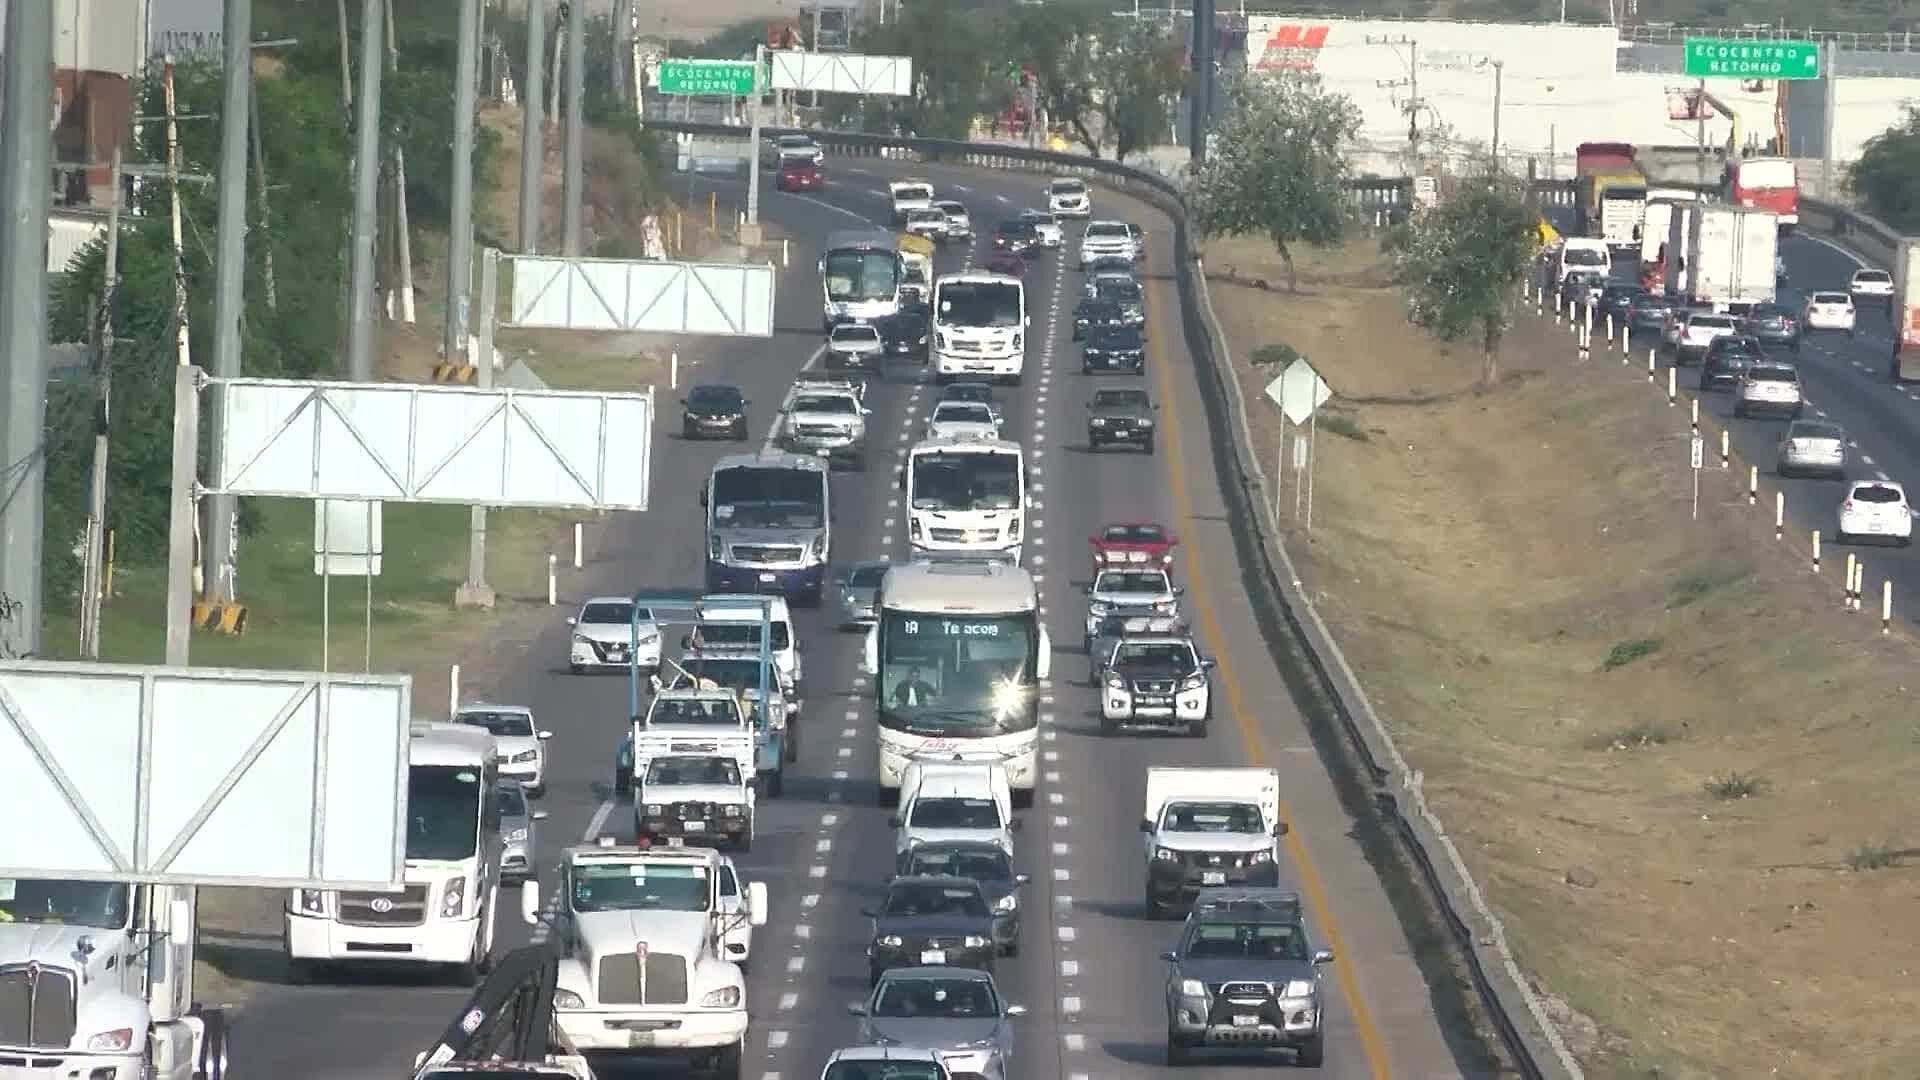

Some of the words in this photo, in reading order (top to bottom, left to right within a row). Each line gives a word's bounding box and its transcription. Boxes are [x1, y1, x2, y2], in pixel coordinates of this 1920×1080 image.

[1695, 45, 1797, 59] ECOCENTRO
[1710, 61, 1781, 73] RETORNO
[668, 68, 751, 80] ECOCENTRO
[679, 80, 737, 90] RETORNO
